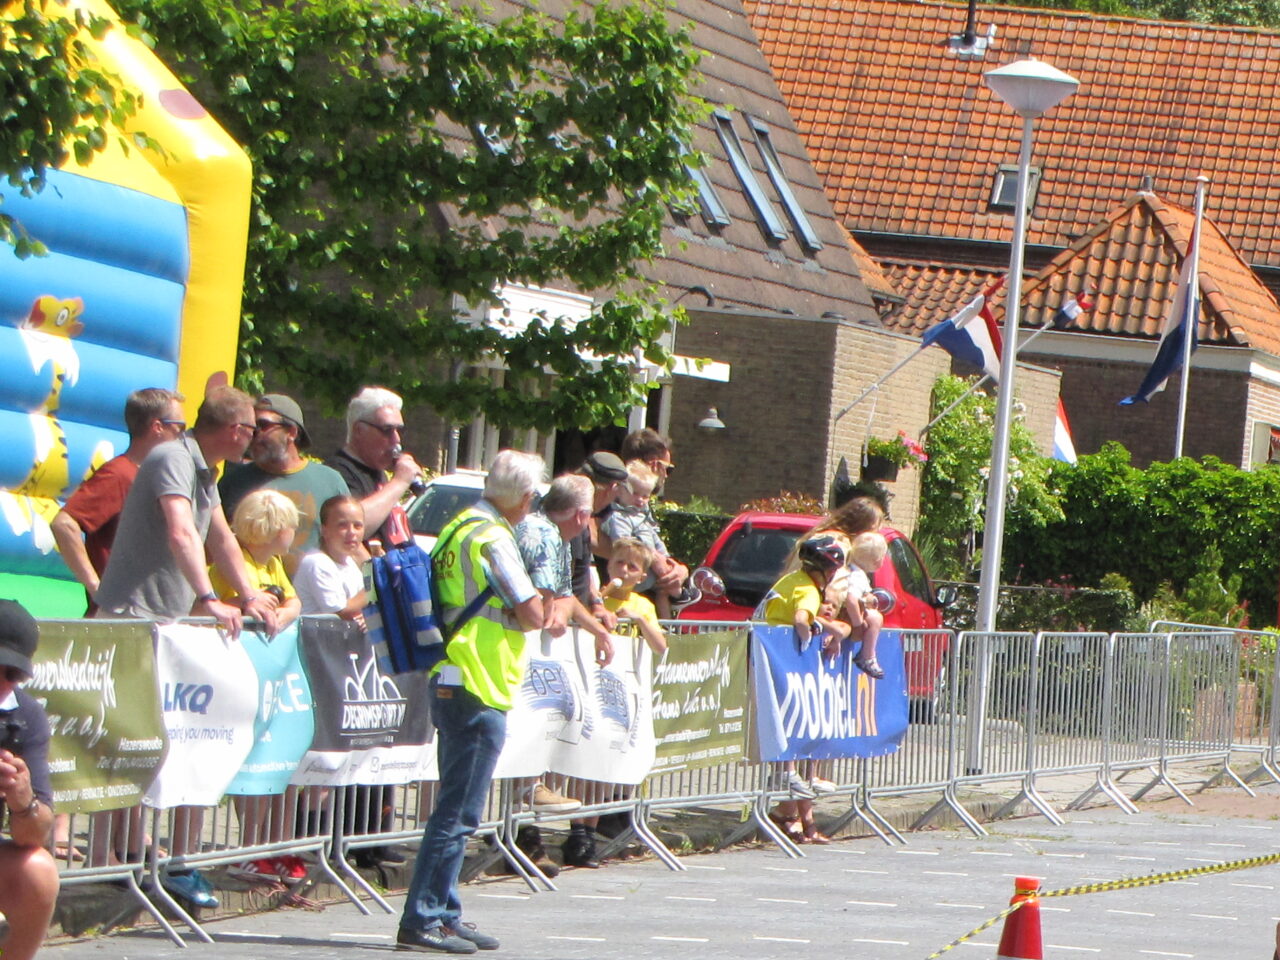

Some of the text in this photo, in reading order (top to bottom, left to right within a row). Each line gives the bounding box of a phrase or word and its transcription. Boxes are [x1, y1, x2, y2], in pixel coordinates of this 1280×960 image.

[164, 683, 214, 715] LKQ
[779, 650, 878, 740] mobiel.nl
[184, 727, 200, 743] you
[200, 724, 234, 745] moving
